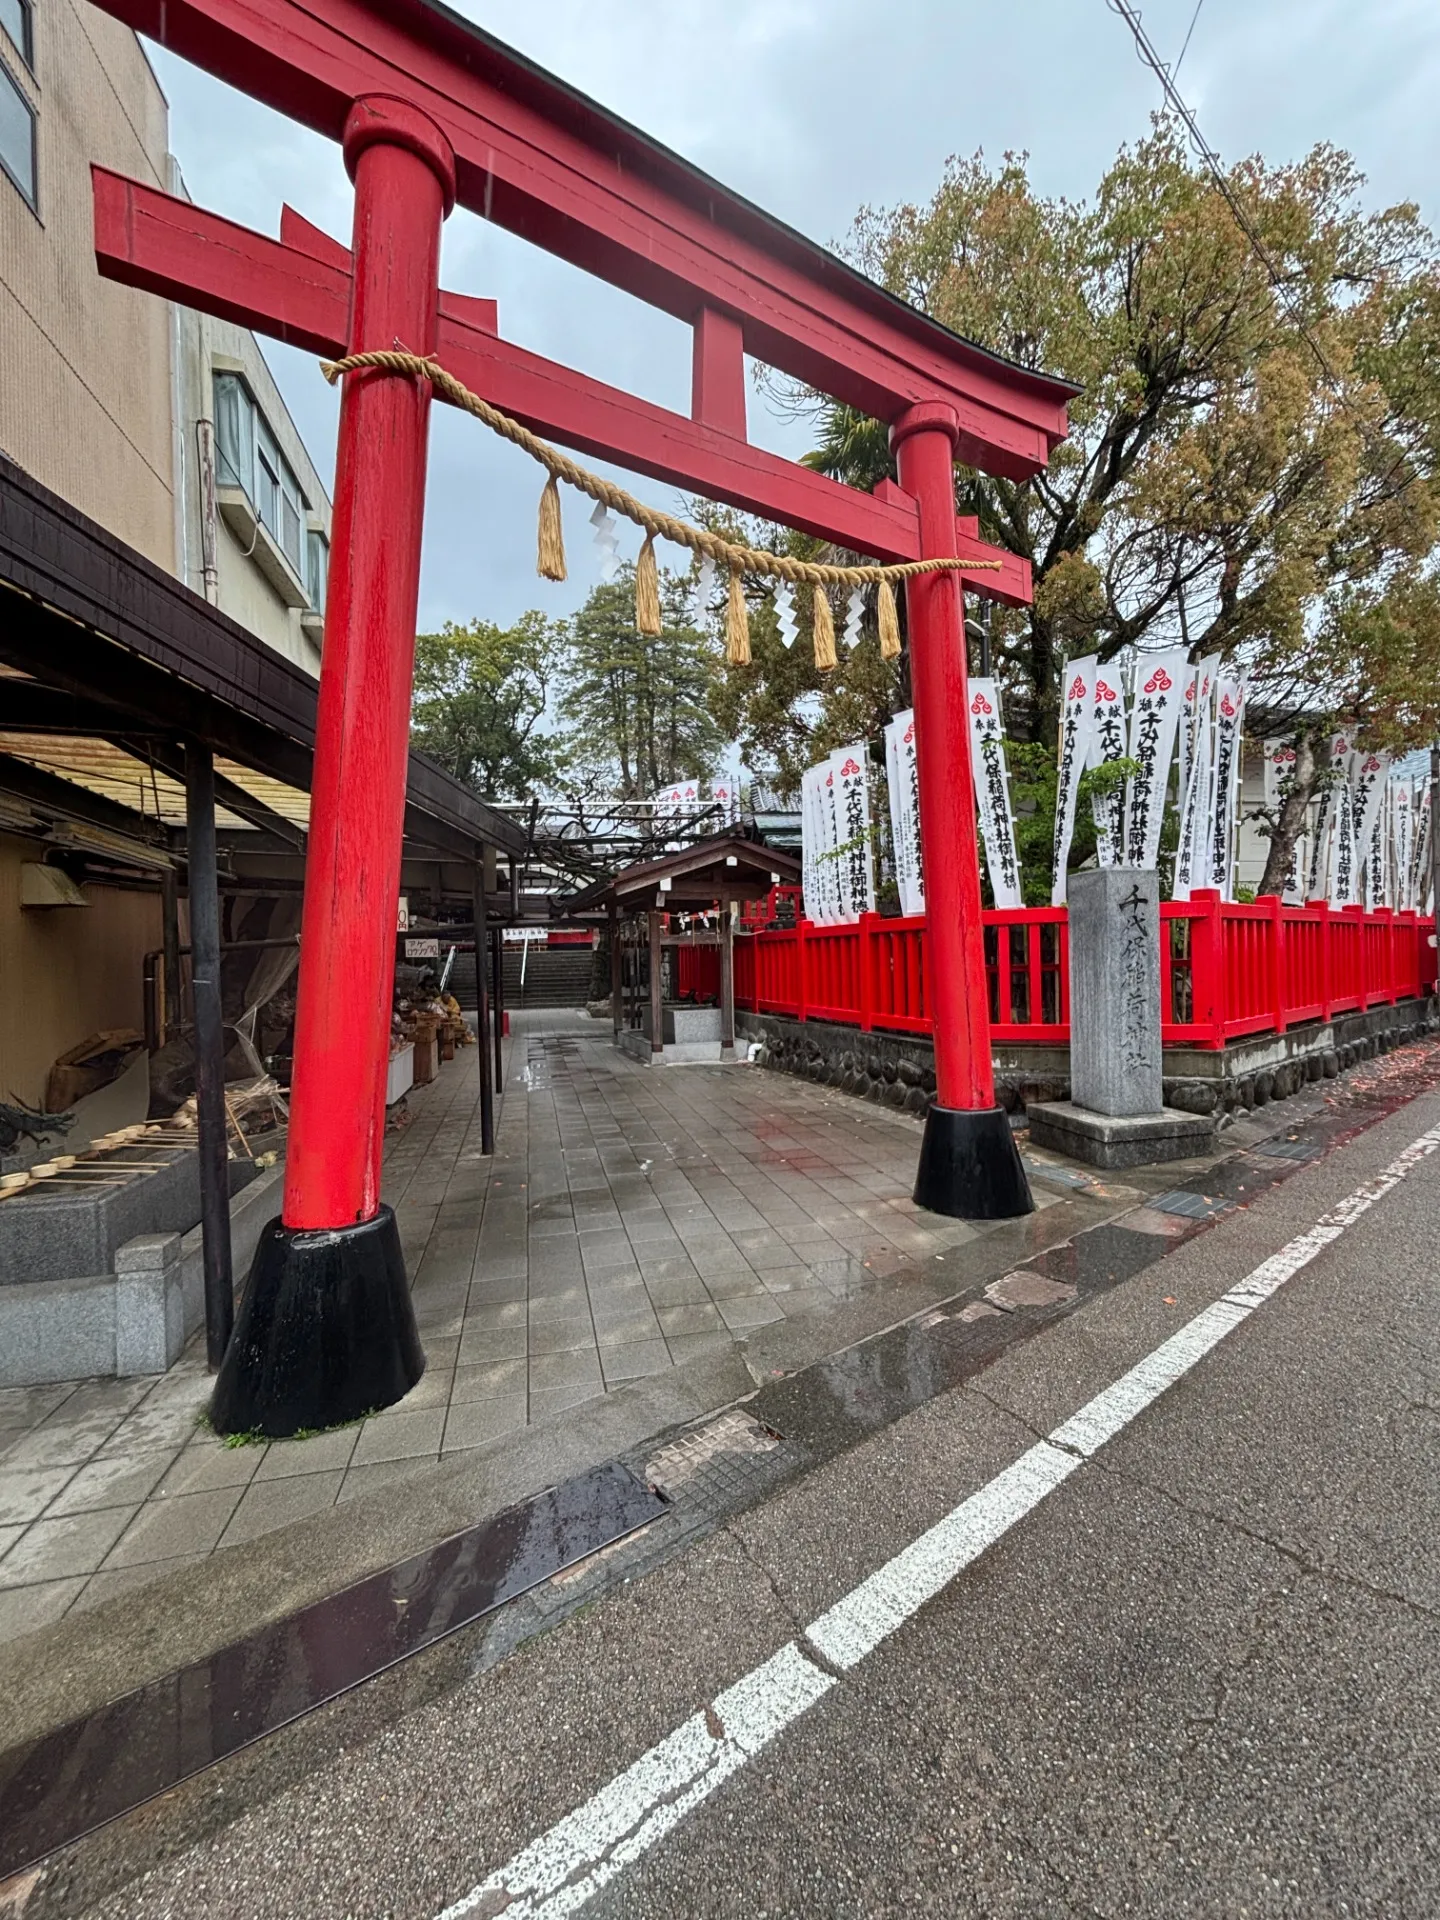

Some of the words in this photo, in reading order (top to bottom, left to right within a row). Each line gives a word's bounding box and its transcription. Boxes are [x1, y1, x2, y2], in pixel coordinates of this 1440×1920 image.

[1094, 704, 1123, 720] 奉献
[975, 718, 997, 732] 奉献
[843, 776, 864, 789] 奉献
[845, 788, 870, 913] 千代保稲神社御神徳
[1117, 884, 1152, 1070] 千代保稲荷神社
